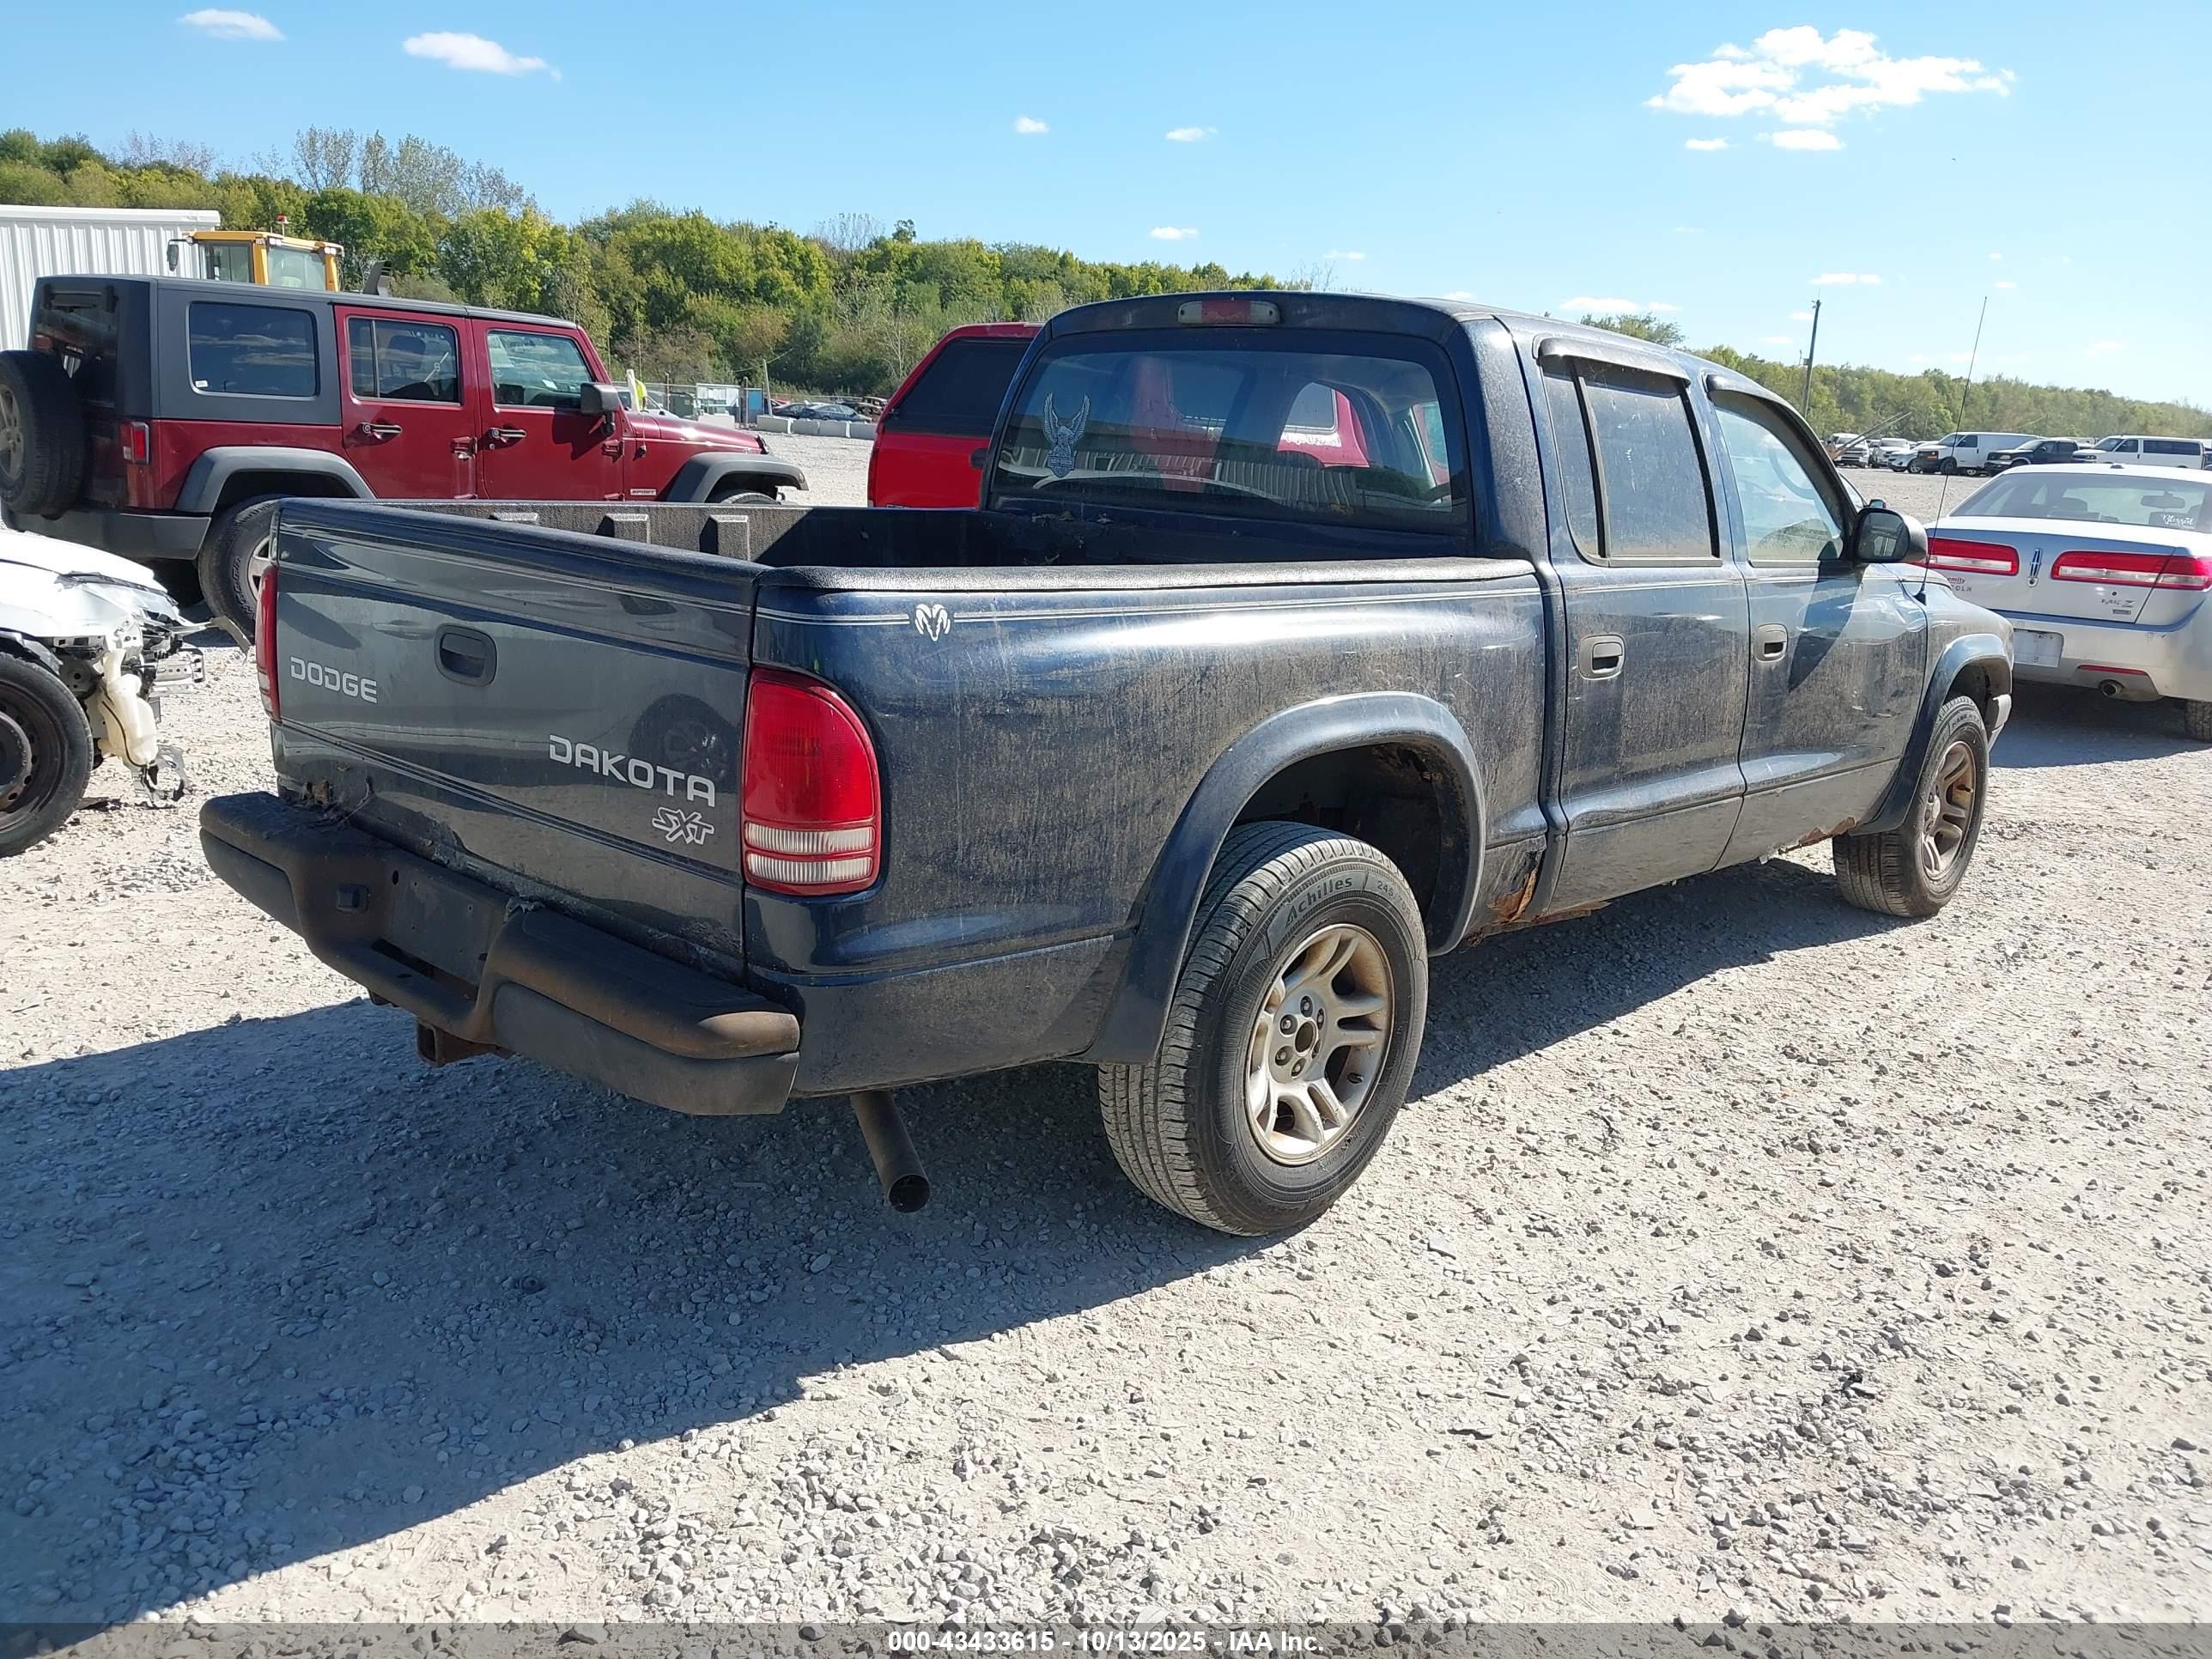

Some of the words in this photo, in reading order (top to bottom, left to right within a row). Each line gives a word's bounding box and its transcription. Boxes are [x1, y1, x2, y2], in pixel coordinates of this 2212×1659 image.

[290, 656, 378, 704] DODGE
[549, 734, 715, 808] DAKOTA
[652, 806, 715, 846] SXT
[1285, 878, 1353, 928] Achilles
